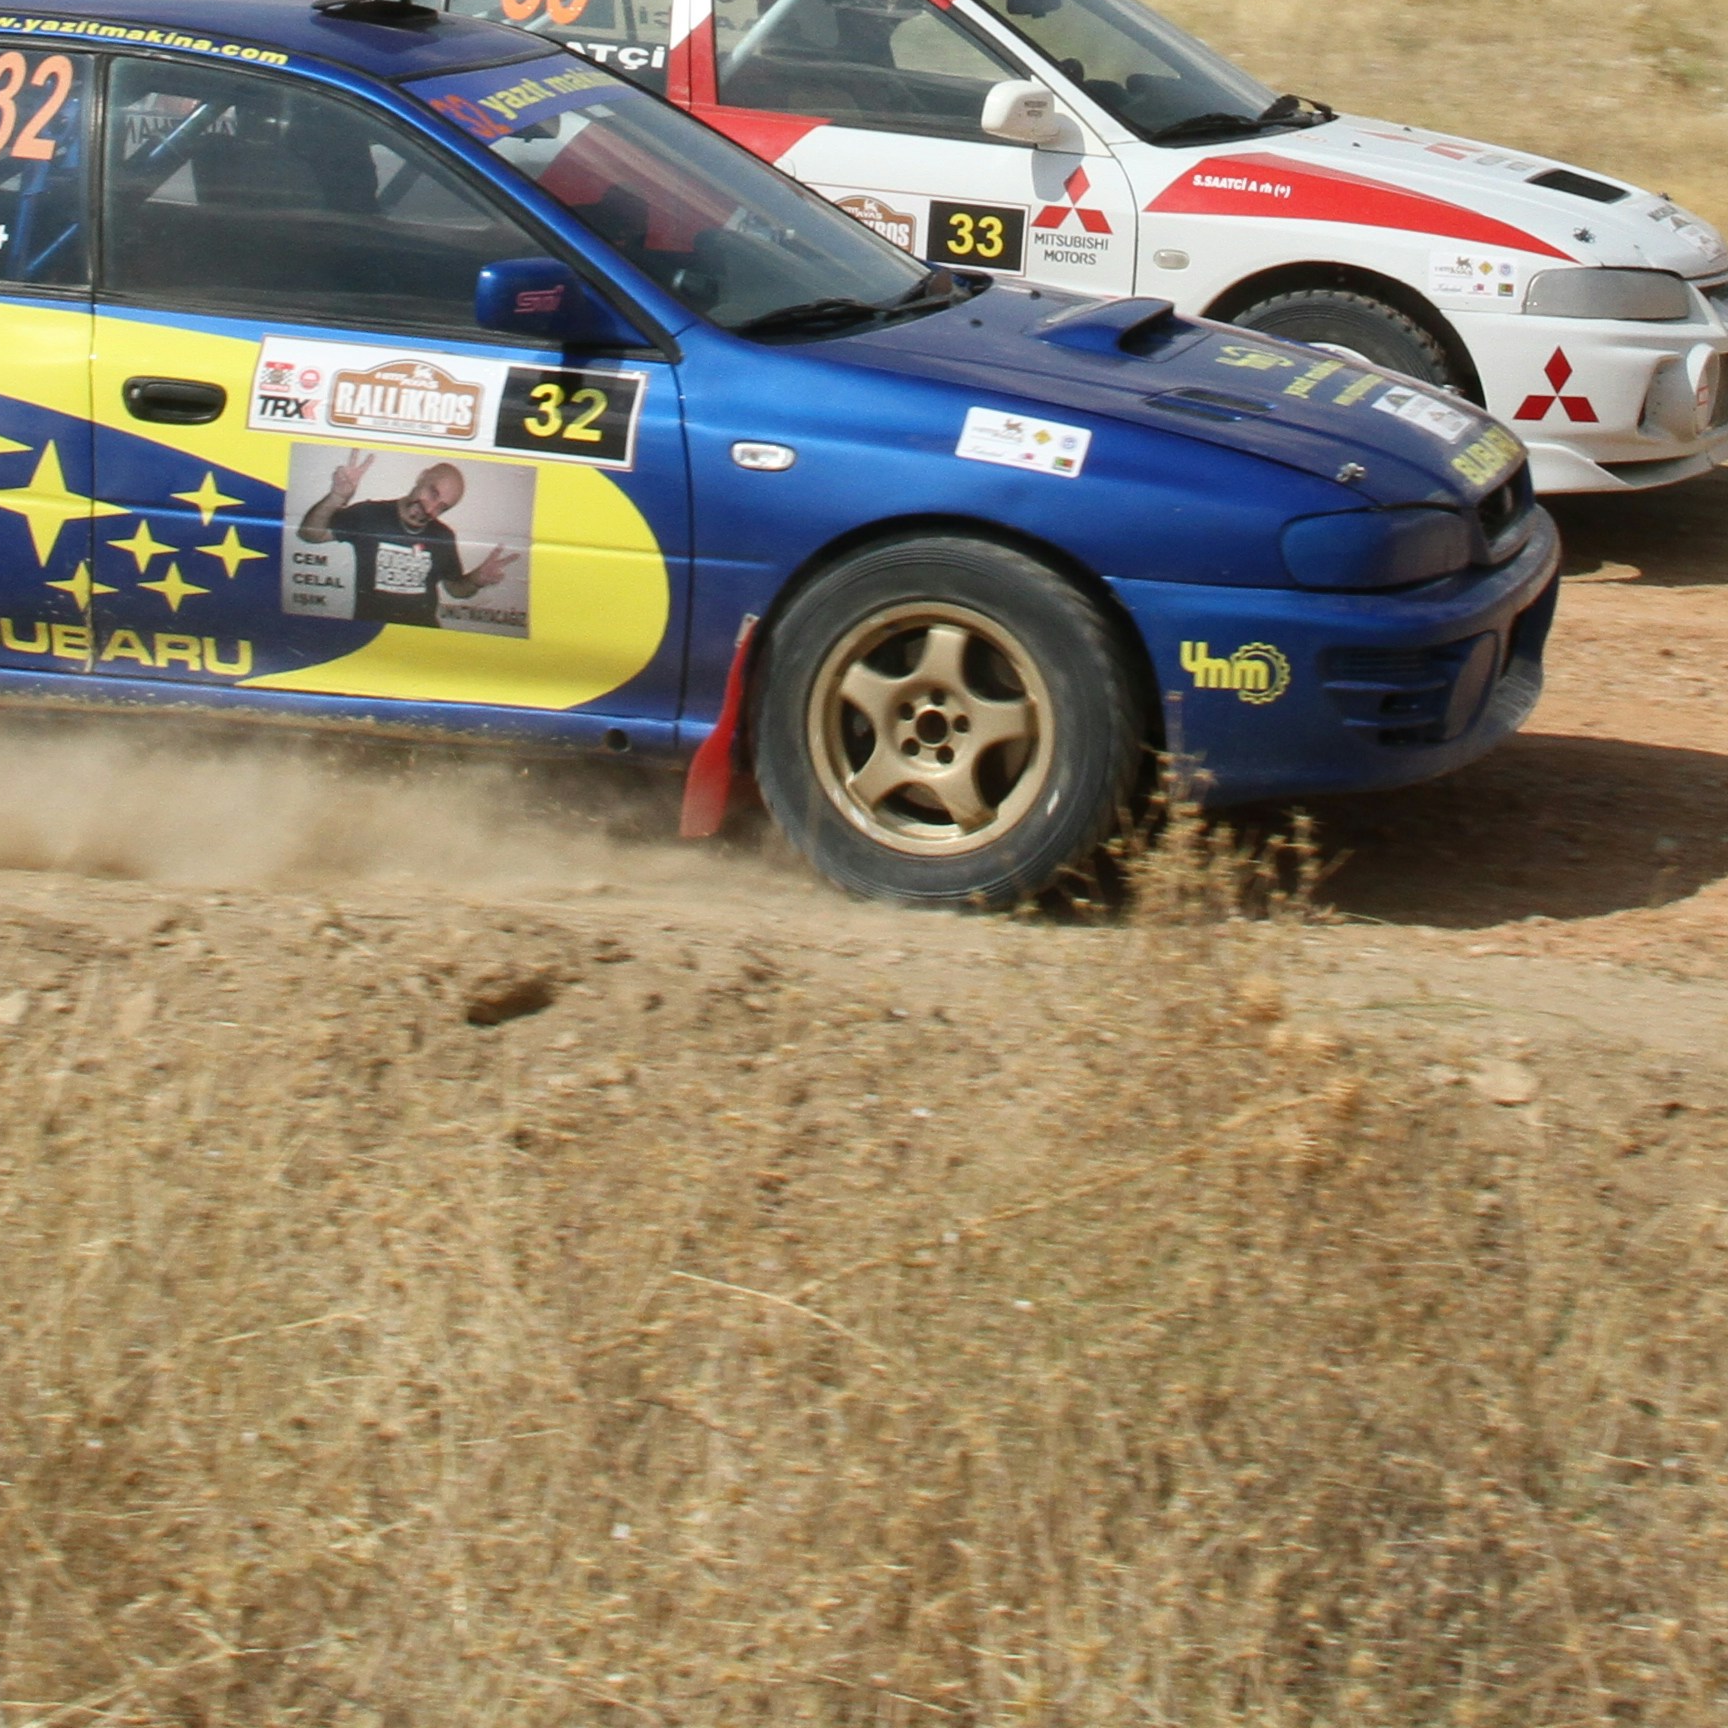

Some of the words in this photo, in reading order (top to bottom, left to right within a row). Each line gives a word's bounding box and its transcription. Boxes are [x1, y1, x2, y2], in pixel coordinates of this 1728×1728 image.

[946, 212, 1004, 259] 33
[1033, 231, 1110, 252] MITSUBISHI
[1043, 249, 1097, 266] MOTORS
[257, 393, 312, 420] TRX
[523, 382, 609, 443] 32
[292, 551, 329, 567] CEM
[292, 572, 345, 589] CELAL
